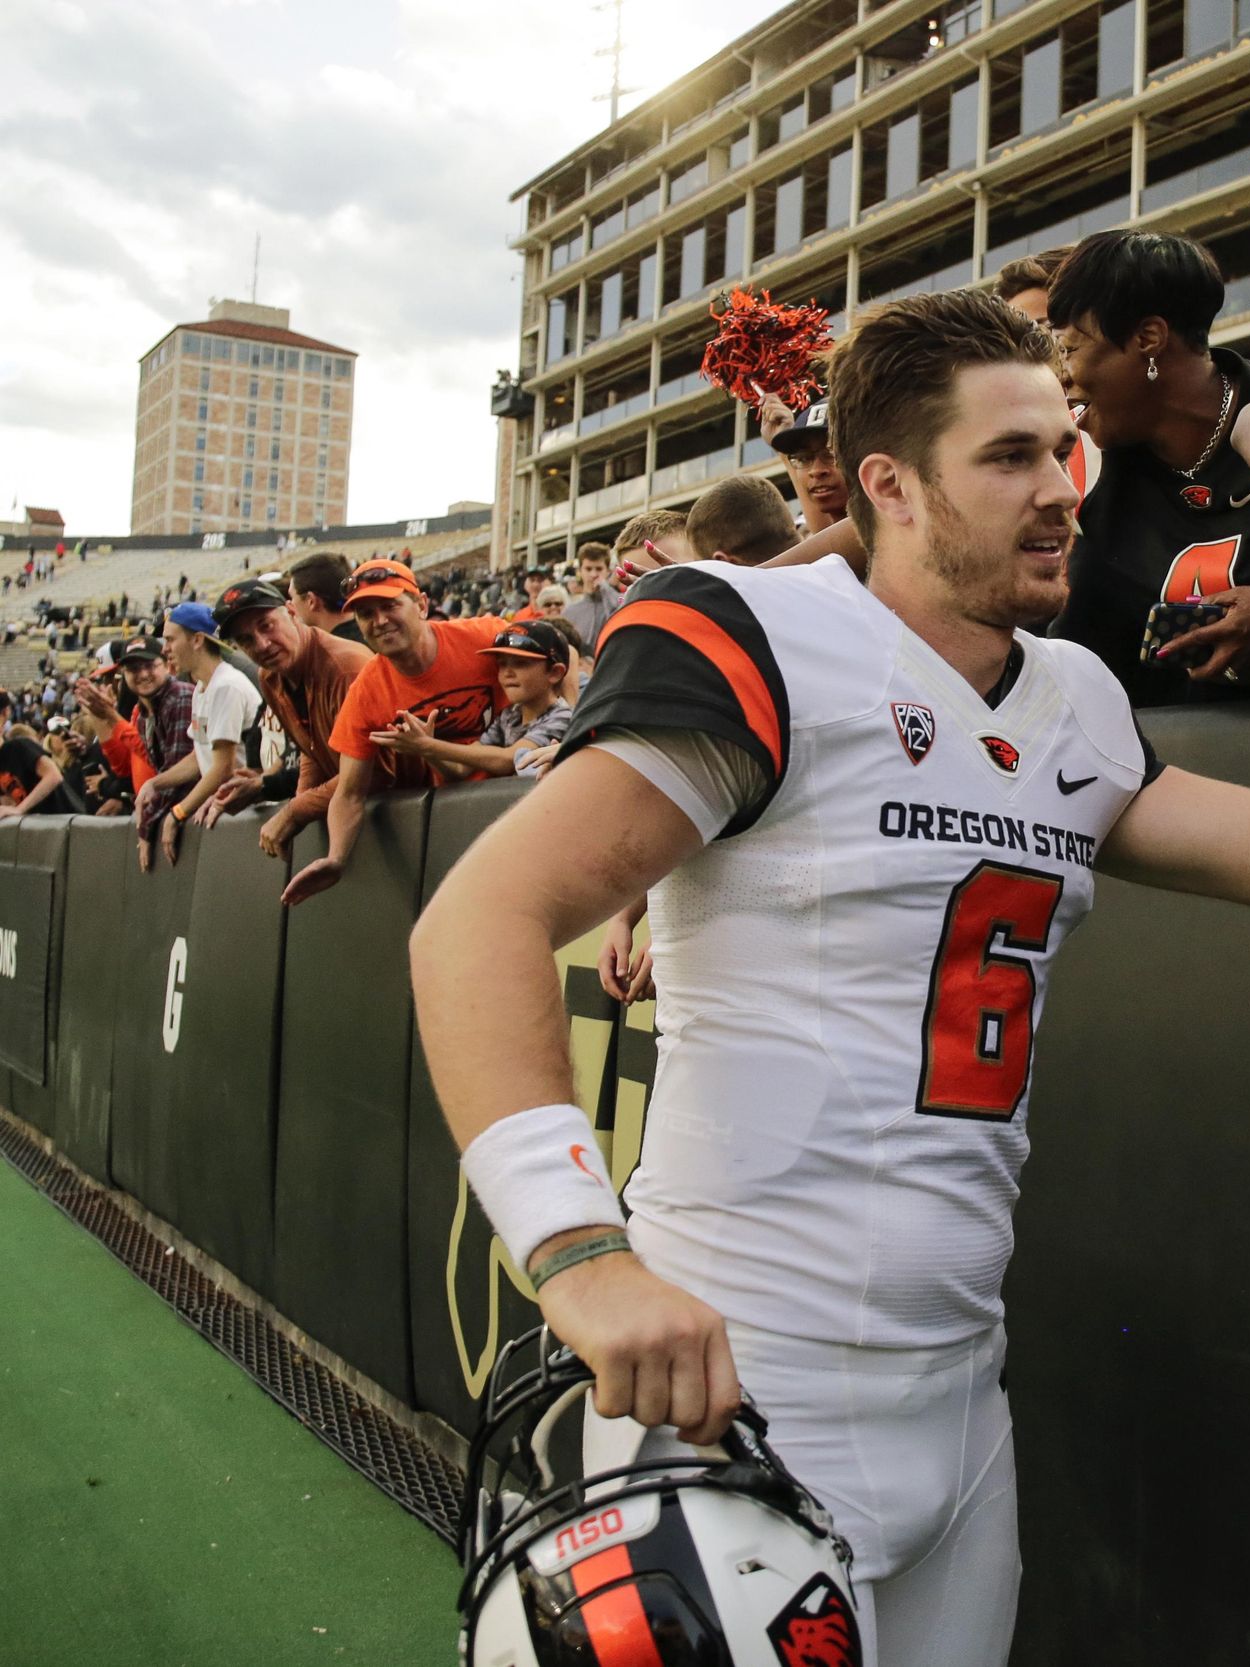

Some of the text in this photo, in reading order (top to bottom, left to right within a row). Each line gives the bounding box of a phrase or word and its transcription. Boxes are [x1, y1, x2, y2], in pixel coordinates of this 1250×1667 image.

[894, 704, 933, 741] PAC
[907, 727, 927, 752] 12
[879, 801, 1096, 869] OREGON STATE
[162, 936, 188, 1053] G
[915, 858, 1065, 1123] 6
[554, 1507, 624, 1559] OSU
